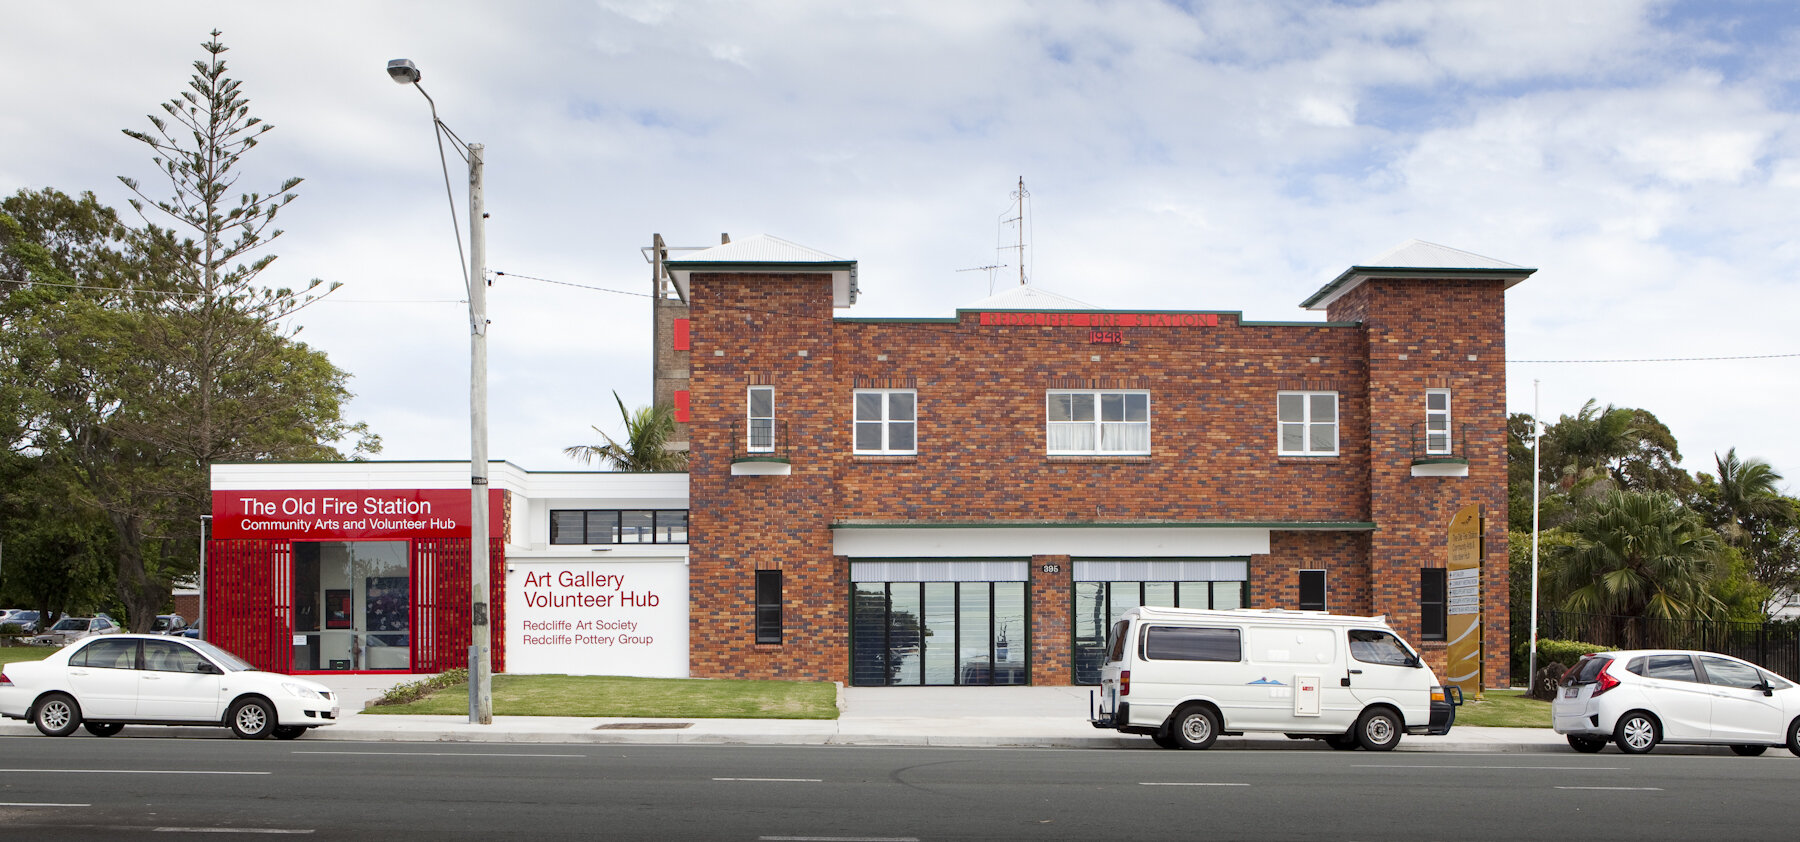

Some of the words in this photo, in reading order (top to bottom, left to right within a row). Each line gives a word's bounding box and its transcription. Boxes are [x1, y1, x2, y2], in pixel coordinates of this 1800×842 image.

[989, 312, 1074, 326] REDCLIFFE
[1088, 313, 1120, 327] FIRE
[1135, 313, 1208, 327] STATION
[1091, 331, 1122, 344] 1948
[239, 497, 276, 515] The
[282, 497, 316, 515] Old
[322, 497, 358, 515] Fire
[363, 497, 431, 515] Station
[240, 518, 311, 533] Community
[314, 518, 340, 530] Arts
[343, 518, 366, 530] and
[369, 518, 427, 530] Volunteer
[430, 518, 456, 530] Hub
[1043, 564, 1059, 573] 395
[523, 571, 552, 588] Art
[558, 570, 625, 591] Gallery
[523, 591, 614, 608] Volunteer
[620, 590, 660, 607] Hub
[523, 620, 572, 631] Redcliffe
[575, 620, 593, 630] Art
[595, 619, 638, 632] Society
[523, 634, 572, 645] Redcliffe
[574, 634, 615, 646] Pottery
[618, 634, 654, 646] Group
